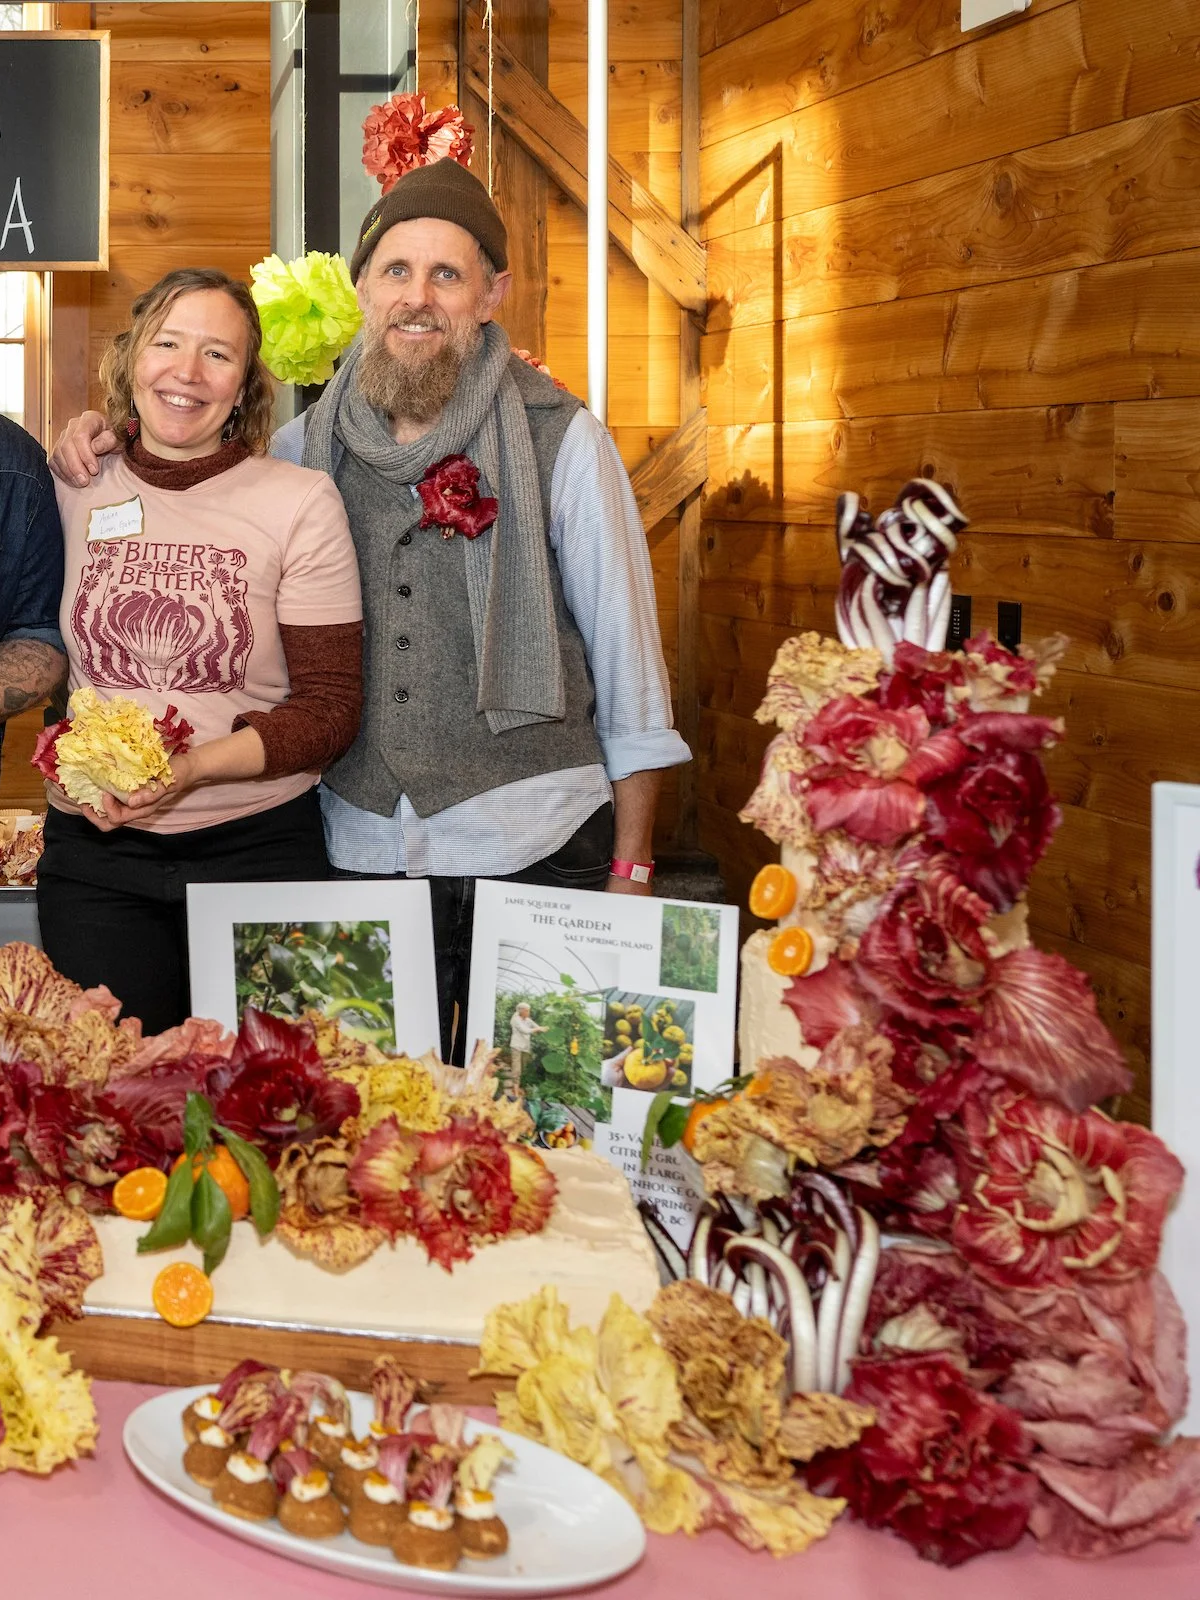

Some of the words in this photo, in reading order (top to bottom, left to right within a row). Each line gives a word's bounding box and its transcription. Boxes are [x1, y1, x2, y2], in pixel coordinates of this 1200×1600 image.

[123, 541, 207, 570] BITTER
[154, 560, 169, 573] IS
[119, 565, 207, 591] BETTER
[505, 897, 525, 905] JANE
[527, 899, 558, 910] SQUIER
[560, 902, 572, 911] OF
[530, 913, 555, 926] THE
[558, 917, 612, 932] GARDEN
[564, 933, 584, 943] SALT
[586, 936, 619, 947] SPRING
[620, 941, 653, 951] ISLAND
[623, 1162, 636, 1172] IN
[669, 1215, 686, 1226] BC
